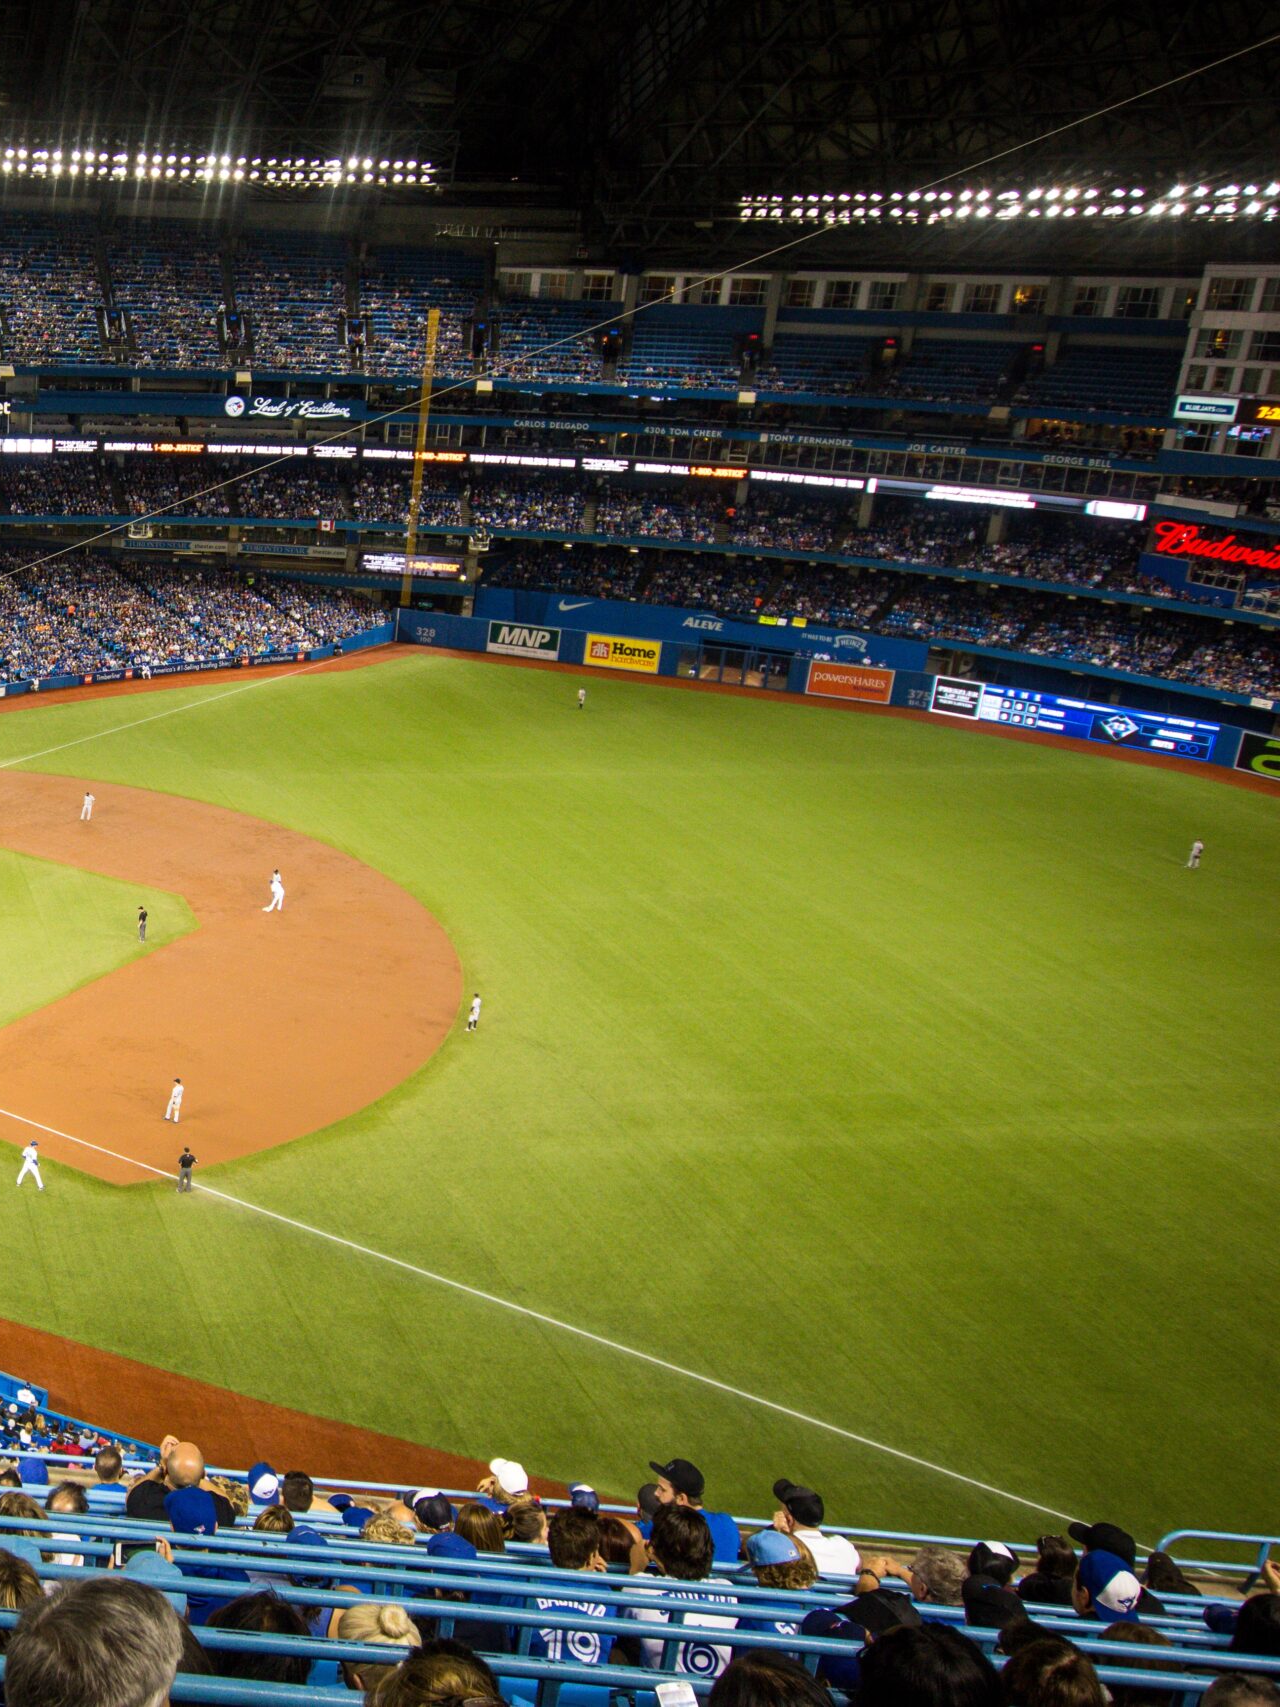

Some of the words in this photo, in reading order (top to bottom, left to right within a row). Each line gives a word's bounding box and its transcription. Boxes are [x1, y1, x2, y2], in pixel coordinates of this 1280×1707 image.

[249, 397, 287, 417] Level
[283, 403, 299, 417] of
[298, 400, 351, 418] Excellence
[514, 420, 546, 429] CARLOS
[549, 421, 590, 431] DELGADO
[644, 426, 666, 435] 4306
[669, 427, 689, 436] TOM
[693, 428, 723, 438] CHEEK
[770, 434, 795, 443] TONY
[798, 435, 853, 447] FERNANDEZ
[136, 443, 153, 451] CALL
[907, 443, 926, 452] JOE
[930, 445, 967, 455] CARTER
[397, 451, 414, 459] CALL
[1043, 455, 1085, 466] GEORGE
[1088, 459, 1112, 468] BELL
[671, 466, 690, 475] CALL
[167, 541, 189, 550] STAR
[285, 546, 306, 555] STAR
[682, 617, 724, 632] ALEVE
[416, 626, 436, 638] 328
[497, 626, 551, 648] MNP
[840, 636, 862, 648] HEINZ
[612, 642, 656, 659] Home
[610, 655, 655, 667] hardware
[153, 665, 176, 674] America's
[201, 661, 217, 669] Roofing
[907, 689, 931, 701] 375
[539, 1628, 601, 1664] 19
